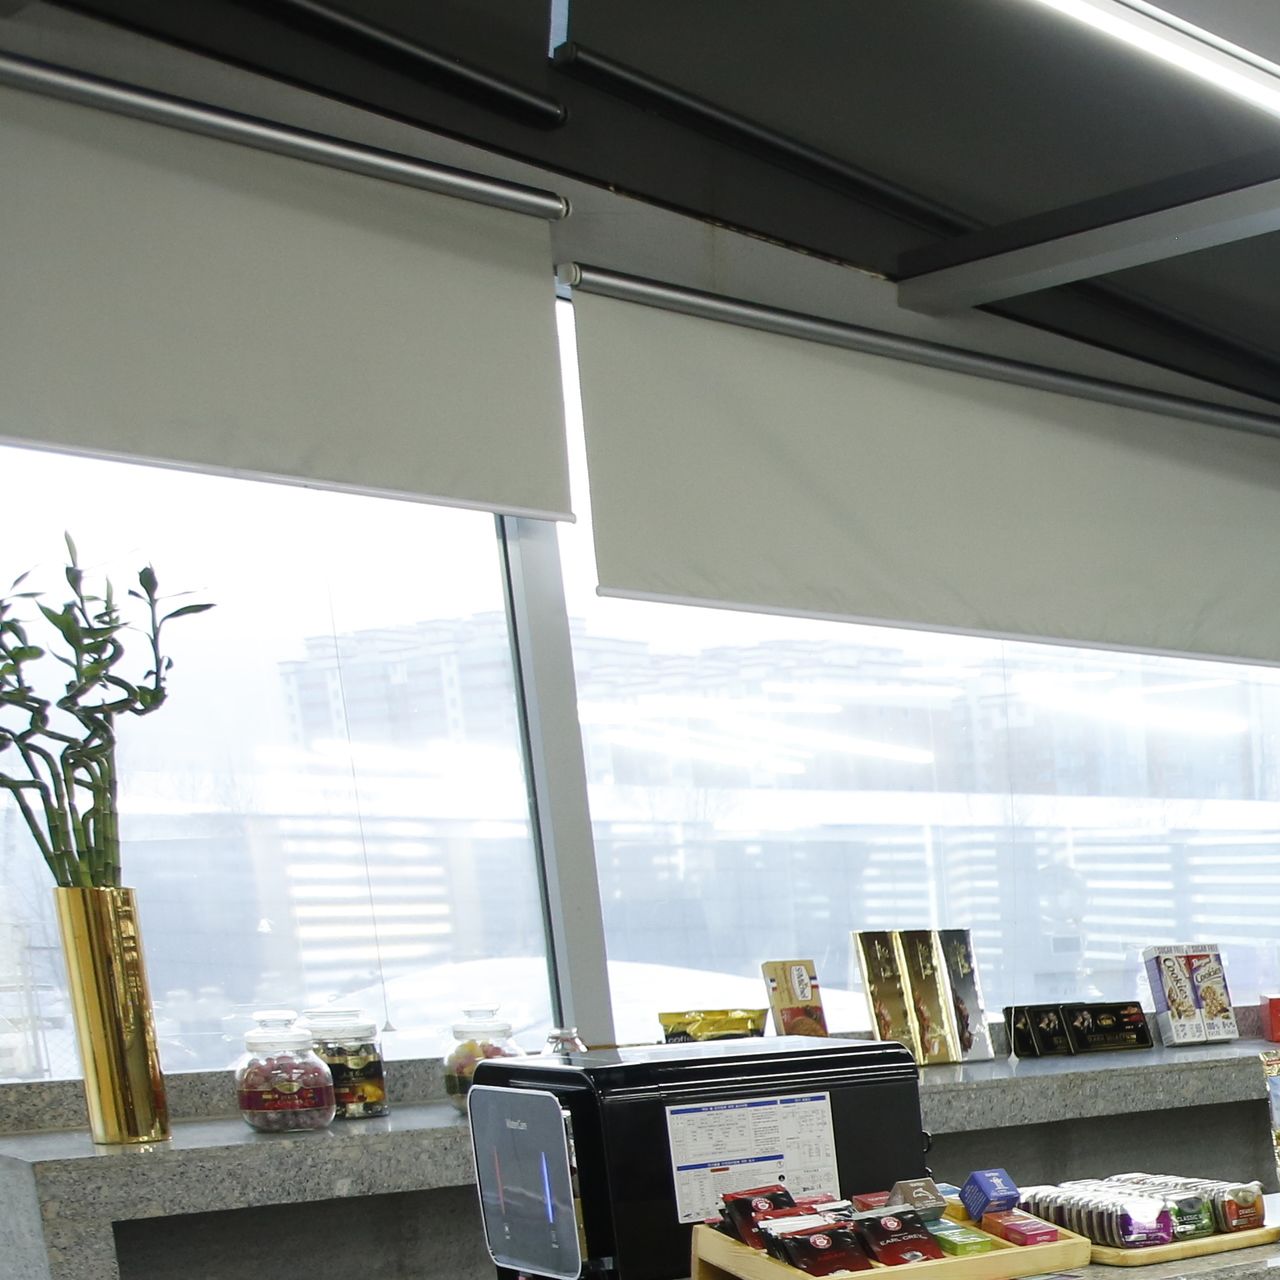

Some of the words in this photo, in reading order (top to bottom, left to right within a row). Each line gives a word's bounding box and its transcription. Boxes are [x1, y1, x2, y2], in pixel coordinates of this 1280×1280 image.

[1163, 957, 1189, 1000] Cookies
[1195, 967, 1222, 984] Cookies
[880, 1236, 900, 1246] EARL
